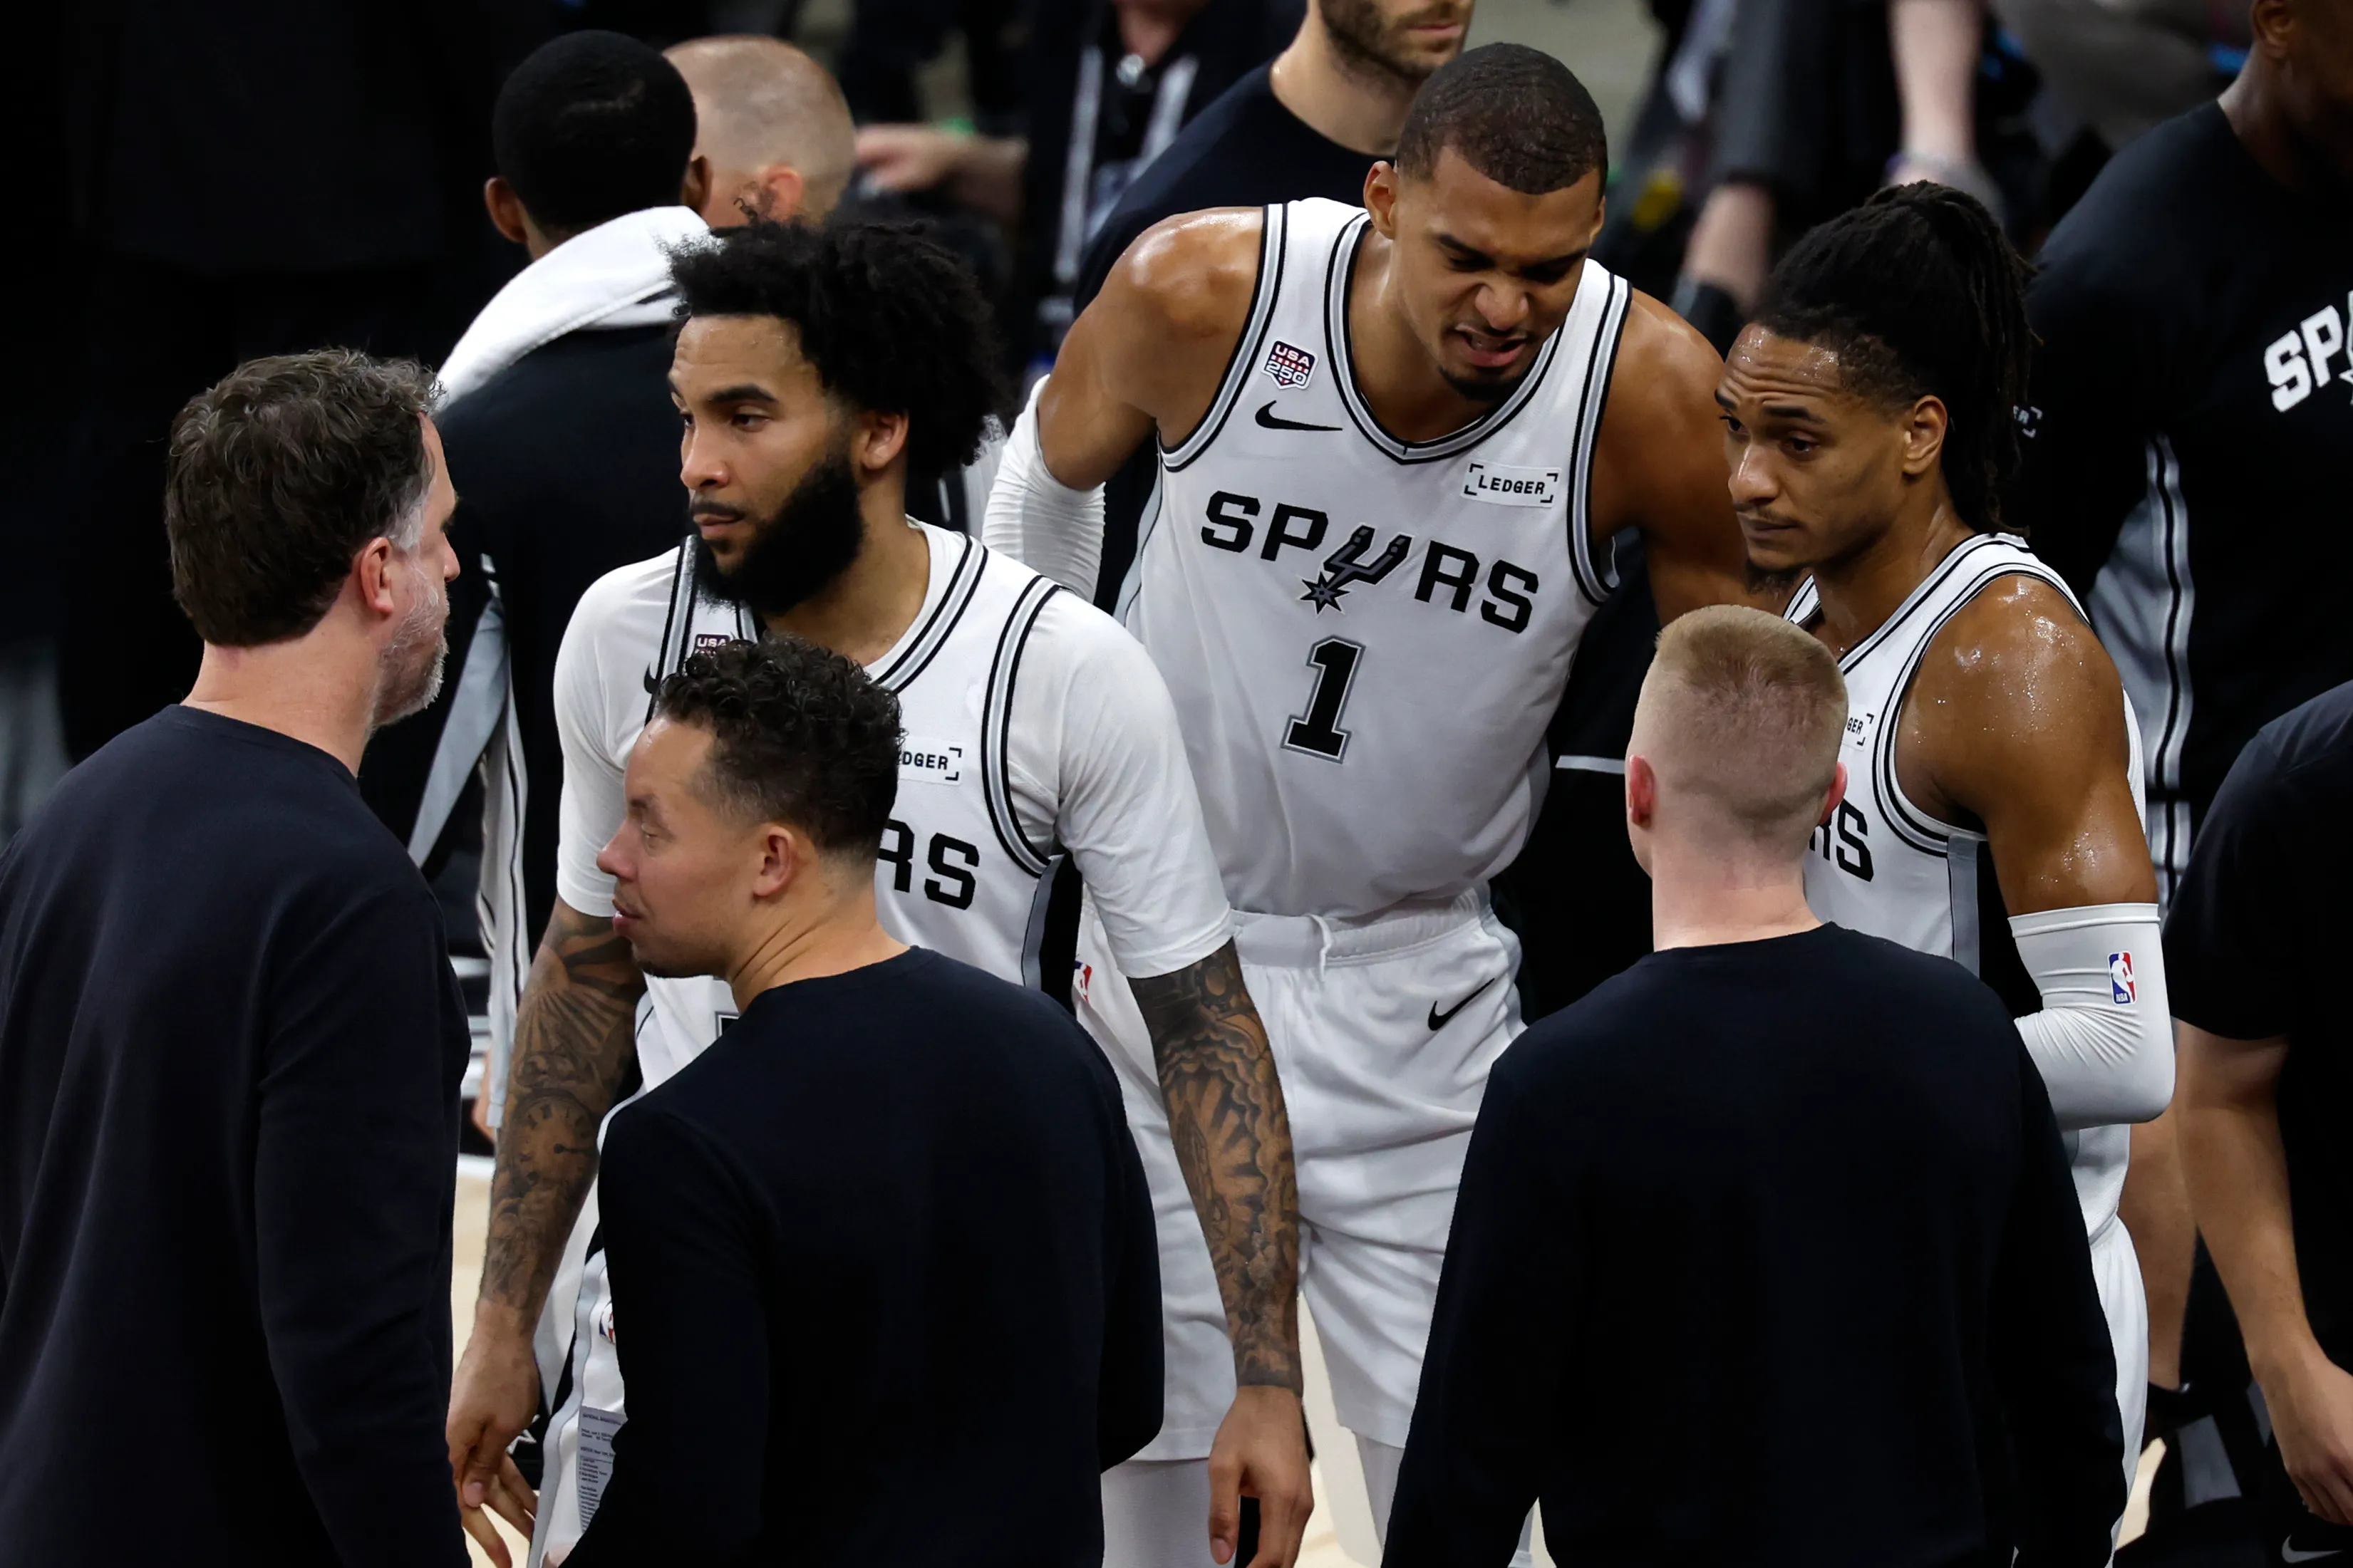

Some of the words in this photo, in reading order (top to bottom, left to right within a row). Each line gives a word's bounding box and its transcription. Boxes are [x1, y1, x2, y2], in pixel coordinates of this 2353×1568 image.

[1274, 343, 1311, 368] USA
[2263, 289, 2353, 413] SP
[1265, 360, 1308, 385] 250
[1478, 474, 1545, 494] LEDGER
[1201, 490, 1539, 634] SPURS
[696, 637, 727, 648] USA
[1281, 635, 1366, 764] 1
[1847, 717, 1863, 734] GER
[897, 750, 948, 770] DGER
[877, 819, 980, 910] RS
